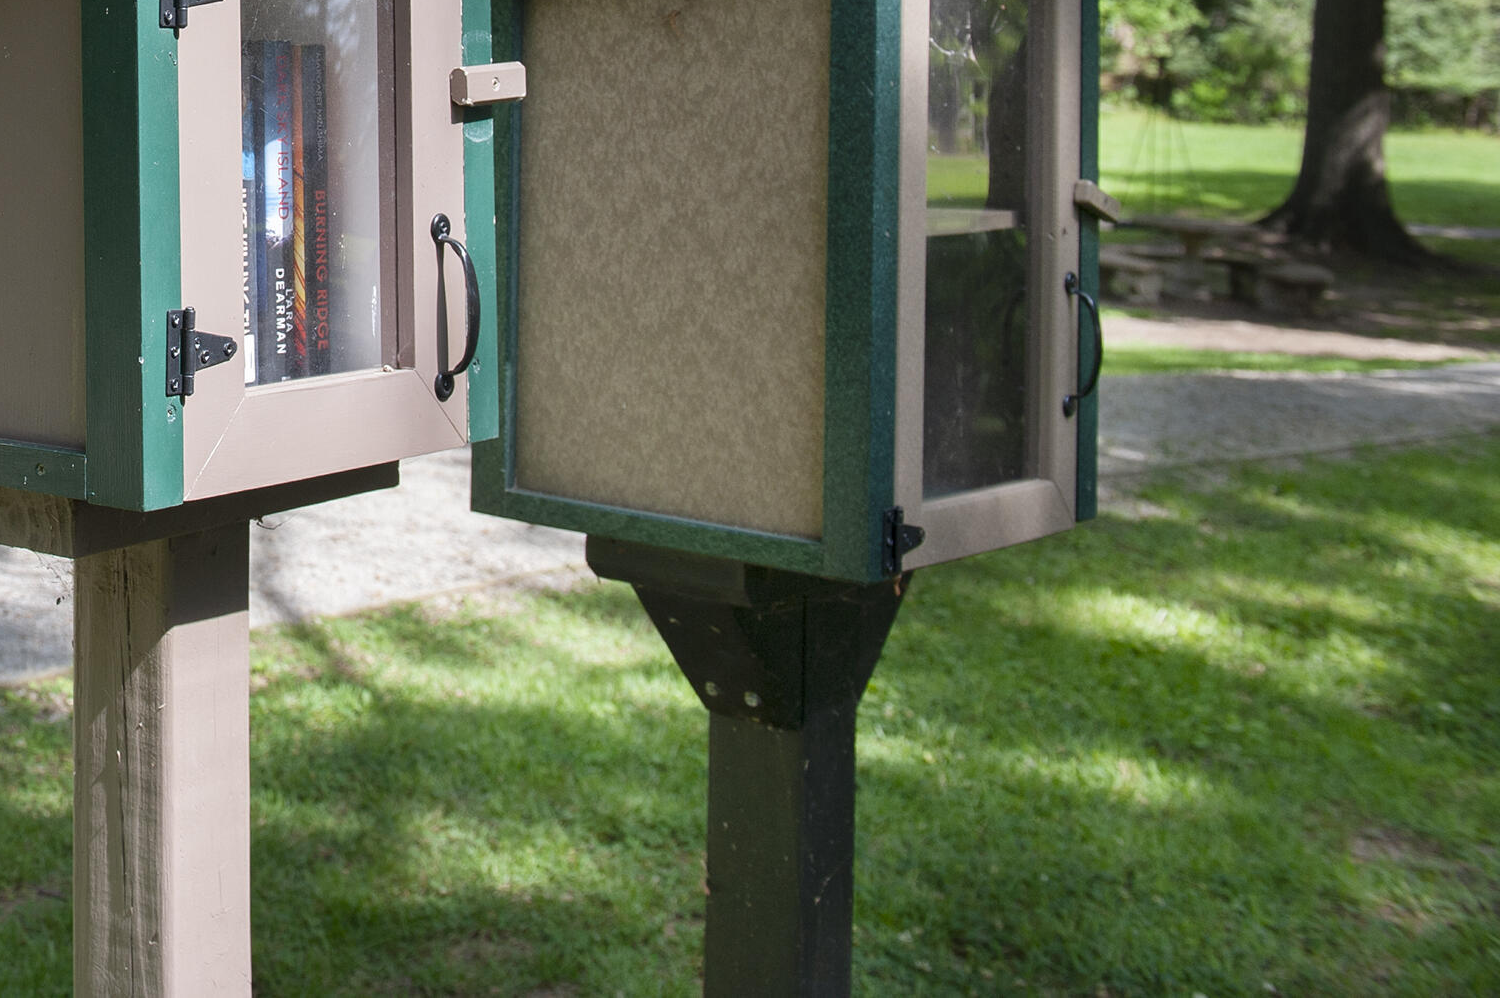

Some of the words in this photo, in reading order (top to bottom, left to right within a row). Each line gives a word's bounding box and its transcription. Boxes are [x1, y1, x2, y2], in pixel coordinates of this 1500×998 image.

[276, 55, 288, 107] DARK
[276, 111, 289, 146] SKY
[278, 152, 289, 220] ISLAND
[315, 190, 328, 282] BURNING
[275, 268, 287, 354] DEARMAN
[317, 289, 329, 351] RIDGE
